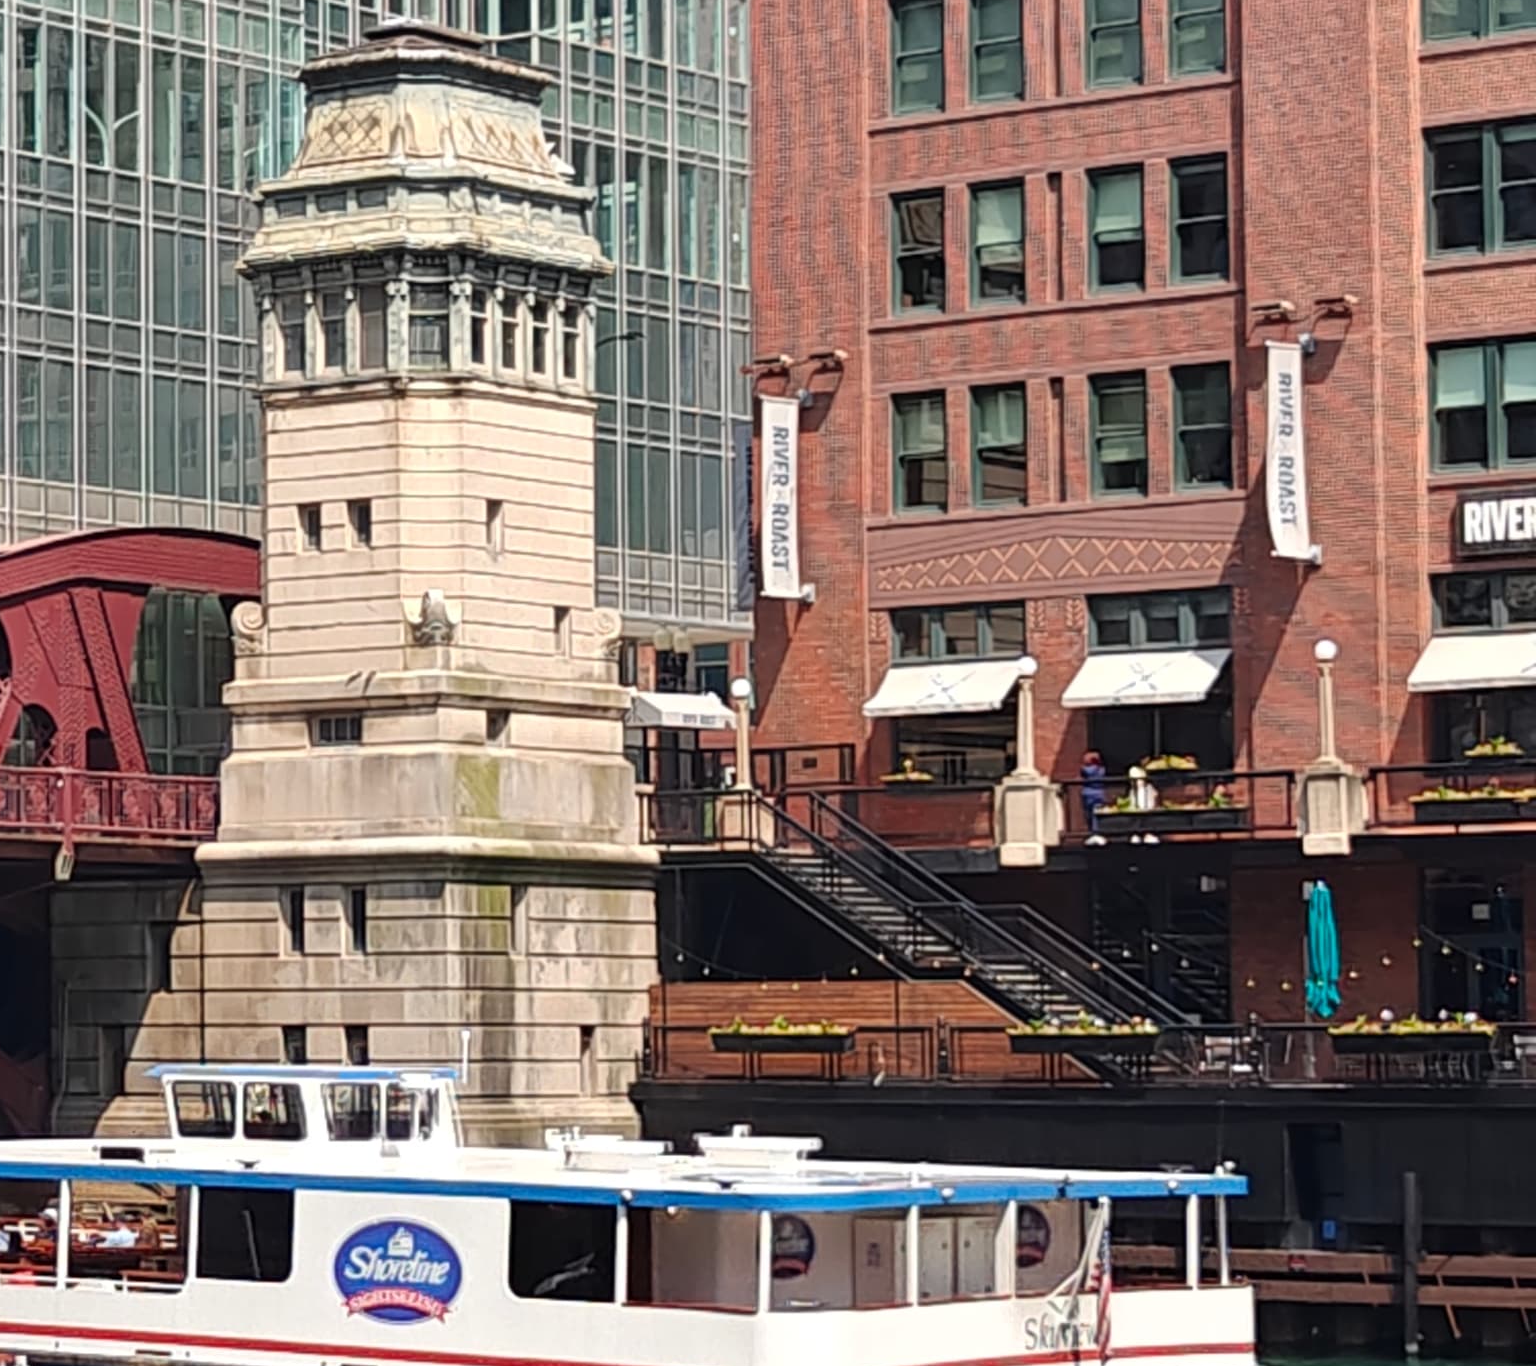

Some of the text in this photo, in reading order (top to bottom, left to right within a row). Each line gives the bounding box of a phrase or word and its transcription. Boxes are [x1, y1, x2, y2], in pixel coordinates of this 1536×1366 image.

[1277, 372, 1298, 526] RIVER ROAST
[771, 425, 790, 573] RIVER ROAST
[1463, 497, 1536, 543] RIVER
[343, 1244, 451, 1285] Shoreline
